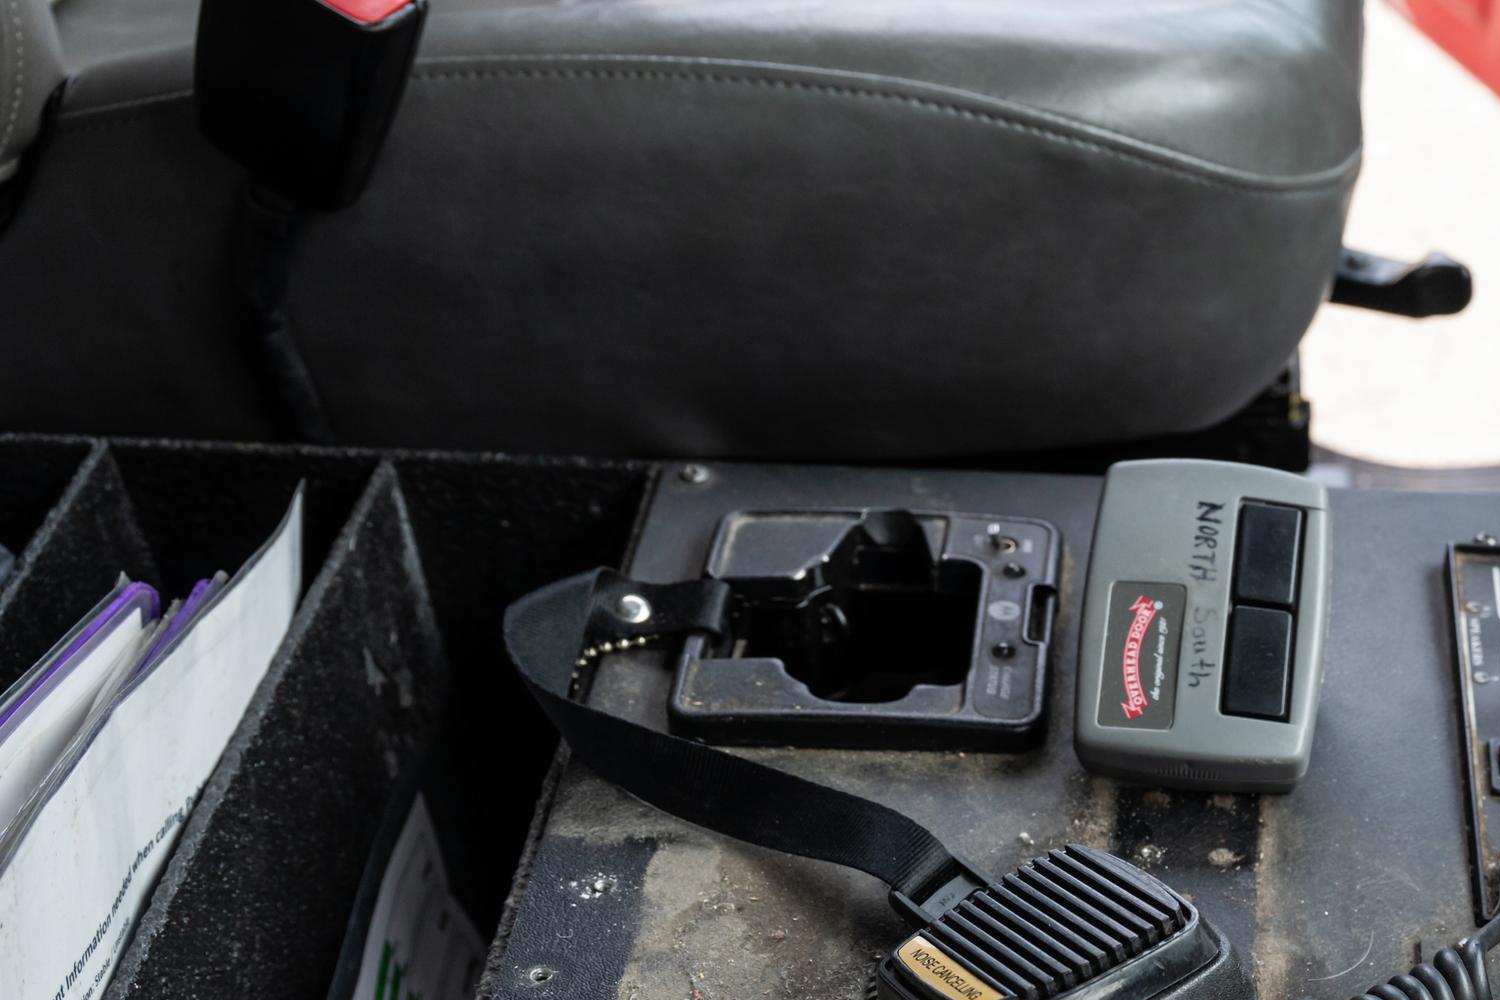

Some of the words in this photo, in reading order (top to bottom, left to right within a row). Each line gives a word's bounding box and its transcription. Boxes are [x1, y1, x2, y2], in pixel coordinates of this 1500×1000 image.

[1188, 500, 1225, 583] NORTH
[1131, 607, 1151, 639] DOOR
[1188, 608, 1217, 688] South
[1126, 641, 1143, 705] OVERHEAD
[66, 912, 112, 991] Information
[111, 865, 133, 917] needed
[132, 840, 154, 873] when
[95, 957, 111, 987] Stable
[911, 948, 937, 969] NOISE
[932, 965, 983, 1000] CANCELLING
